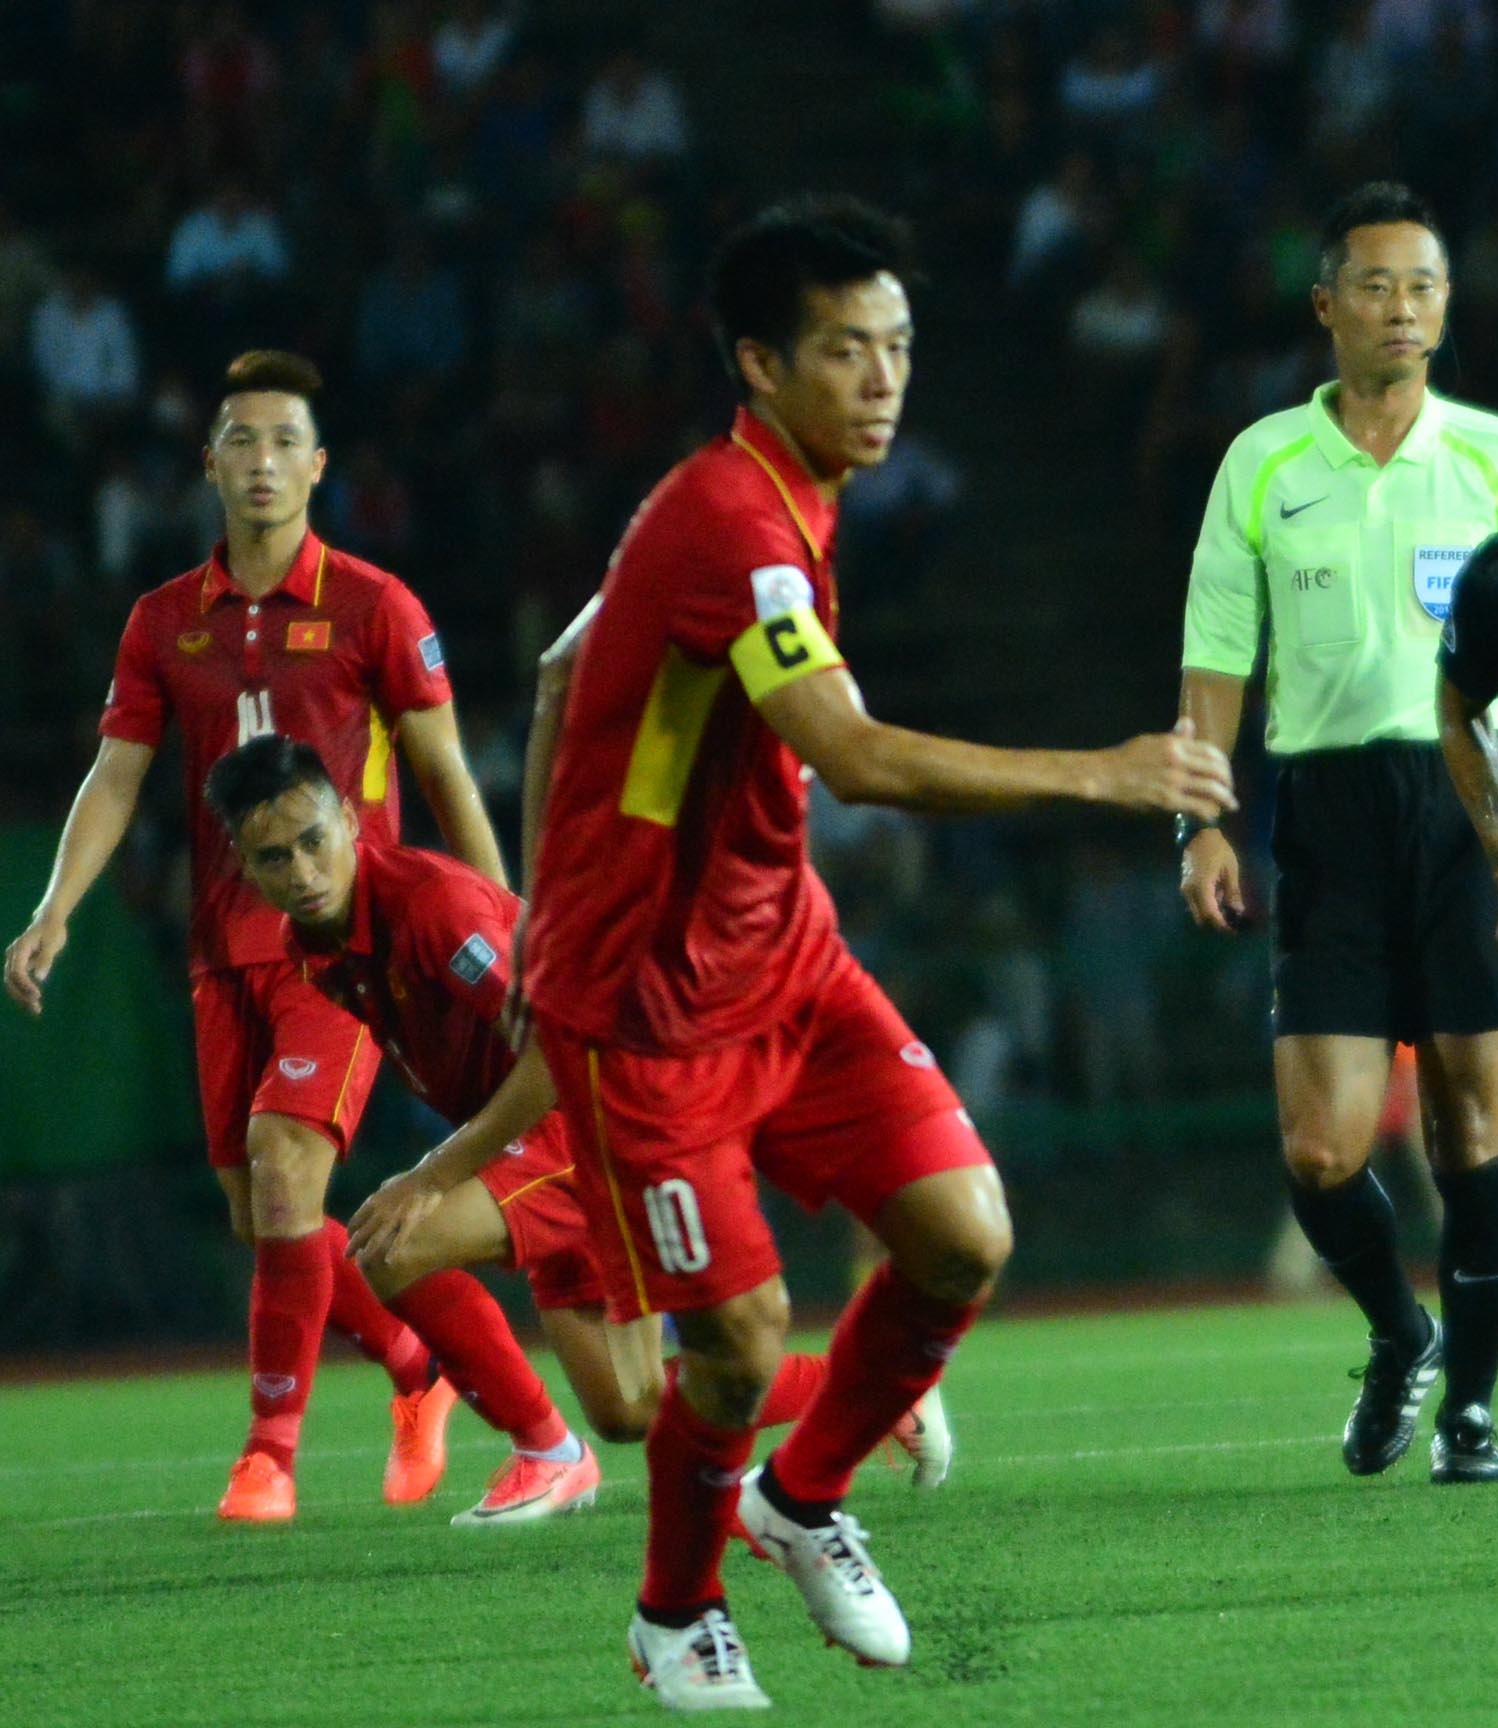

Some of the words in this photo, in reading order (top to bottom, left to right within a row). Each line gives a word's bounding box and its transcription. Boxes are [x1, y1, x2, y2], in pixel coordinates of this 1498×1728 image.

[1290, 566, 1333, 592] AFC
[1427, 575, 1453, 590] FIF
[764, 616, 809, 669] C
[643, 1178, 711, 1273] 10
